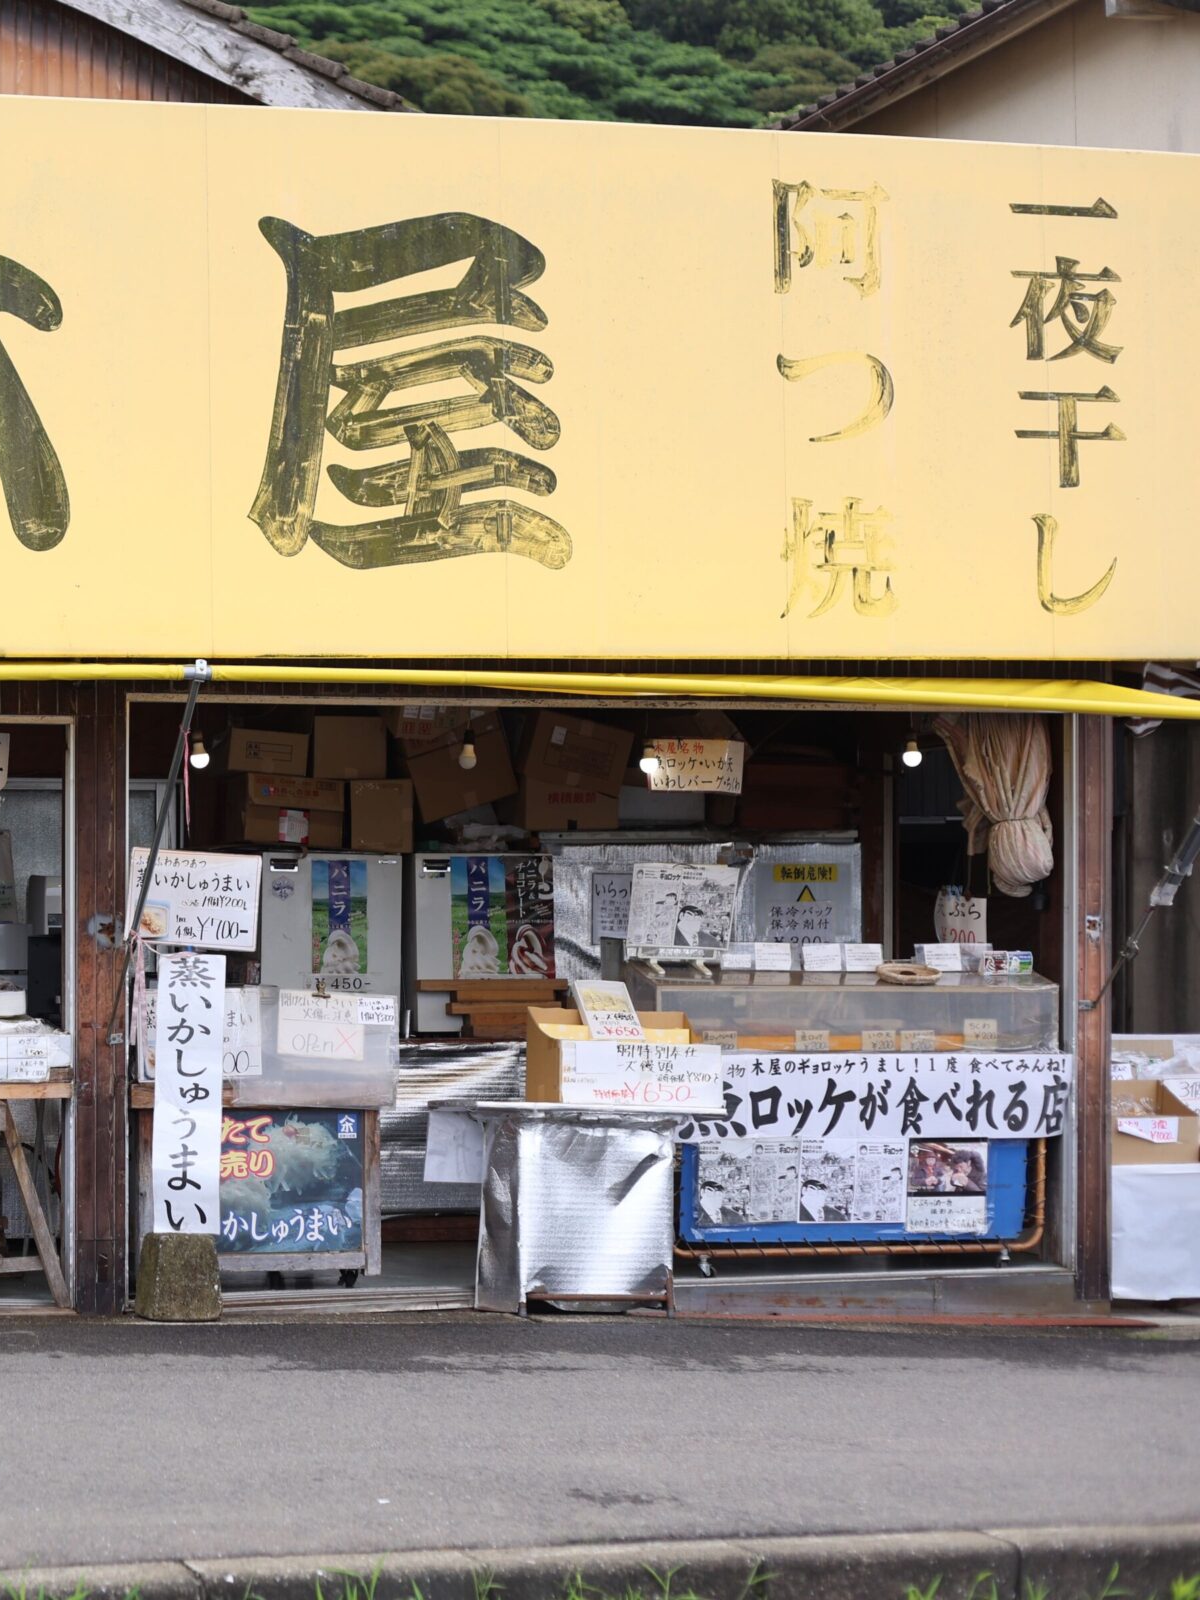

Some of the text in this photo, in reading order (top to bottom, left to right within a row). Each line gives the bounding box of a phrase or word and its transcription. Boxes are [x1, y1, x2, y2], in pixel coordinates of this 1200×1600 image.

[772, 178, 898, 620] 阿つ焼
[1008, 197, 1127, 616] 一夜干し
[330, 865, 349, 917] バニラ
[469, 861, 487, 913] バニラ
[515, 861, 526, 918] チョコレート
[779, 865, 834, 882] 転倒危険!
[770, 904, 834, 919] 保冷パック
[770, 918, 831, 932] 保冷剤付
[164, 957, 217, 1232] 蒸いかしゅうまい
[222, 1208, 353, 1243] かしゅうまい
